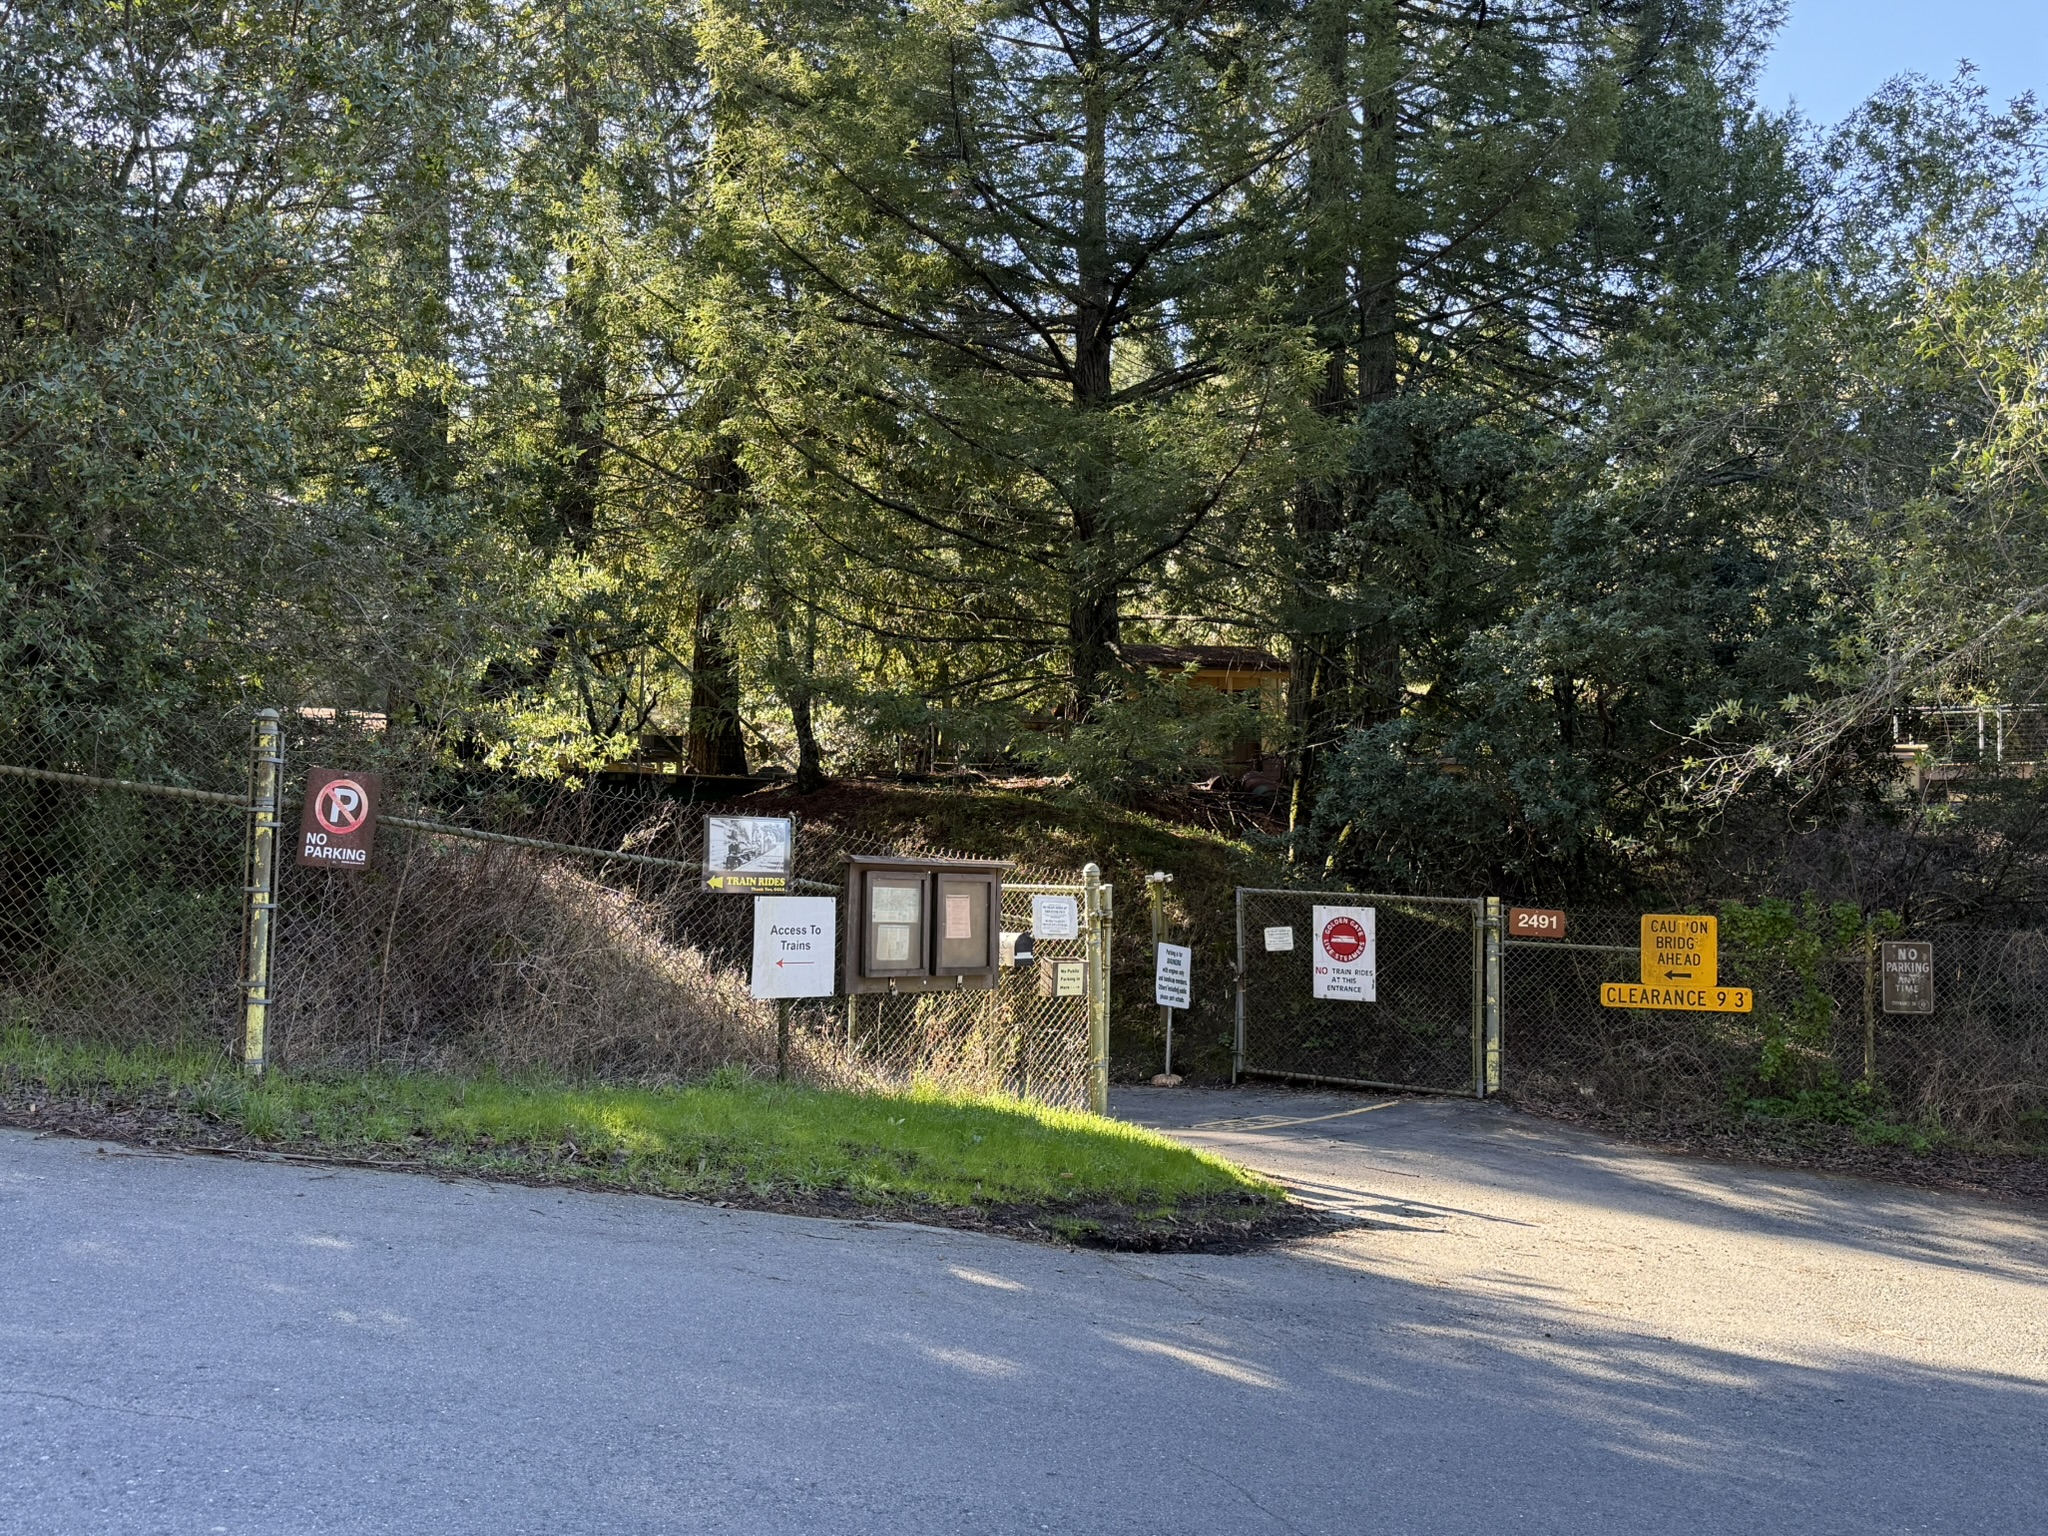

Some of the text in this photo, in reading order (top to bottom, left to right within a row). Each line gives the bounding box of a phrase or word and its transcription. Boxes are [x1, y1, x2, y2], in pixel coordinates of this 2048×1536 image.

[306, 832, 328, 846] NO
[304, 845, 366, 861] PARKING
[726, 876, 786, 887] TRAIN RIDES
[1324, 917, 1364, 936] GOLDEN GATE
[1518, 913, 1557, 929] 2491
[770, 924, 822, 935] Access To
[780, 940, 811, 951] Trains
[1656, 936, 1702, 950] BRIDG
[1323, 938, 1365, 962] LIVE STEAMERS
[1897, 948, 1918, 961] NO
[1657, 952, 1701, 966] AHEAD
[1315, 966, 1328, 975] NO
[1354, 969, 1374, 977] RIDES
[1886, 961, 1930, 973] PARKING
[1327, 984, 1362, 993] ENTRANCE
[1895, 984, 1919, 994] TIME
[1607, 986, 1707, 1006] CLEARANCE
